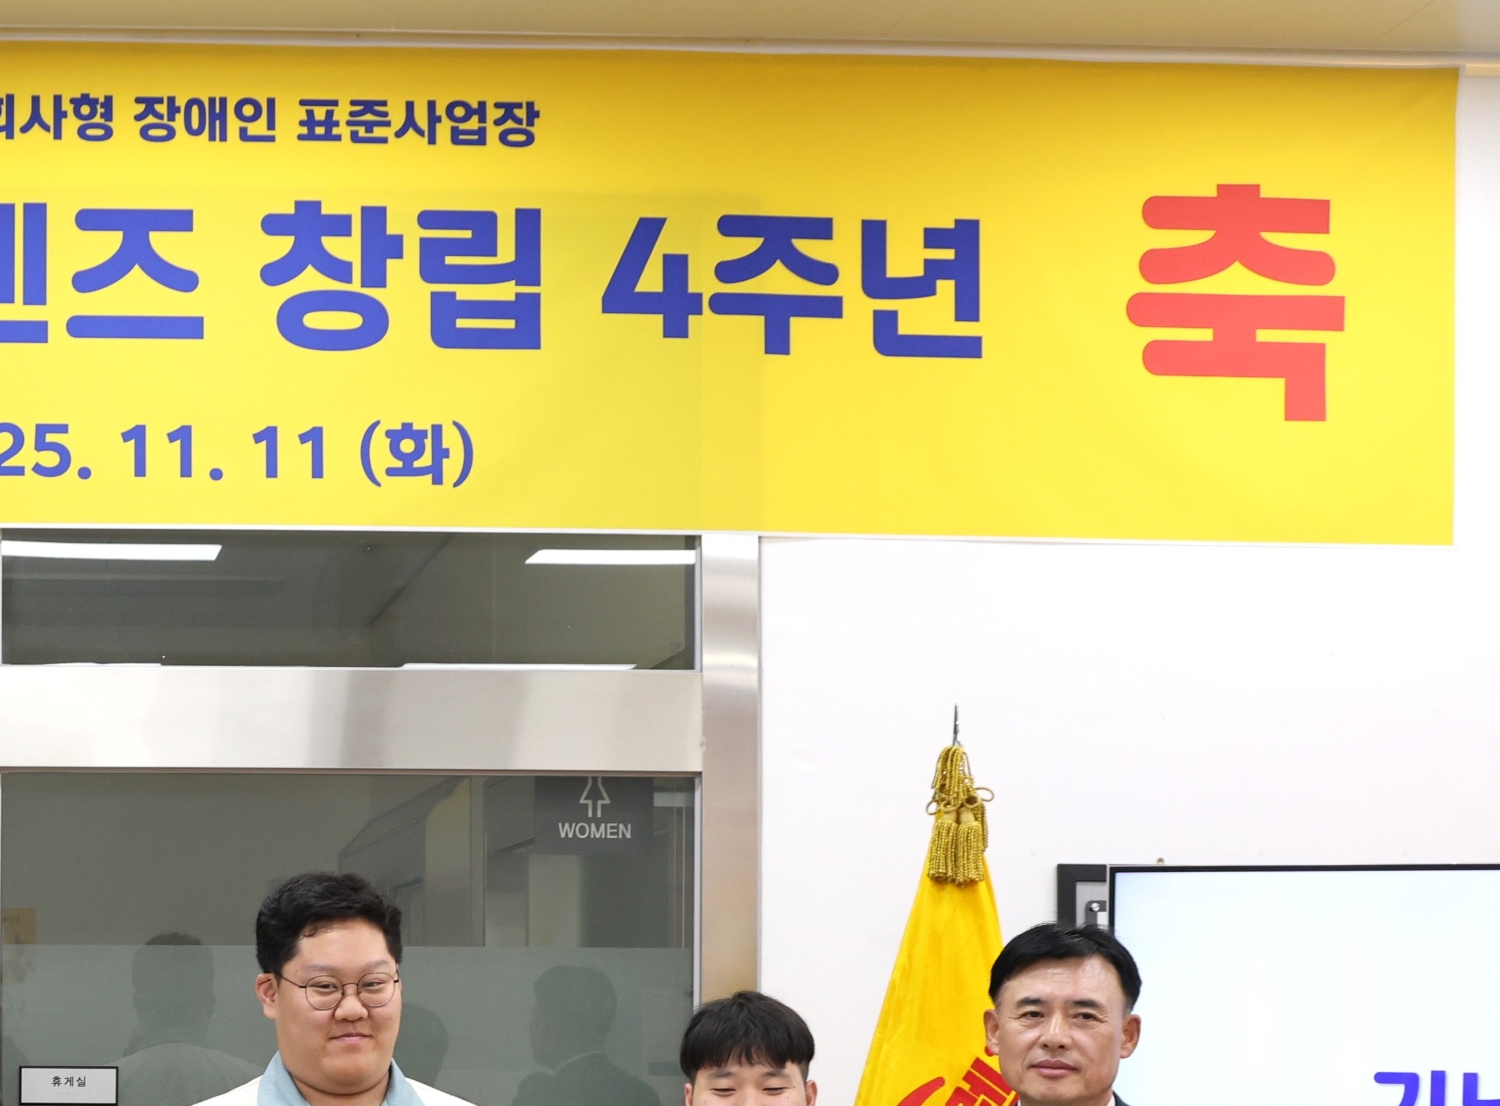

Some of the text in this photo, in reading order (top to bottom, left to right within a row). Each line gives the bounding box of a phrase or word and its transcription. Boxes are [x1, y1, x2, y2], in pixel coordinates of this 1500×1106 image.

[134, 95, 276, 143] 장애인
[297, 98, 540, 148] 표준사업장
[259, 199, 542, 352] 창립
[601, 214, 984, 359] 4주년
[1126, 182, 1346, 423] 축
[120, 423, 224, 482] 11.
[252, 425, 325, 480] 11
[360, 420, 474, 488] (화)
[557, 821, 632, 839] WOMEN
[51, 1075, 87, 1088] 휴게실
